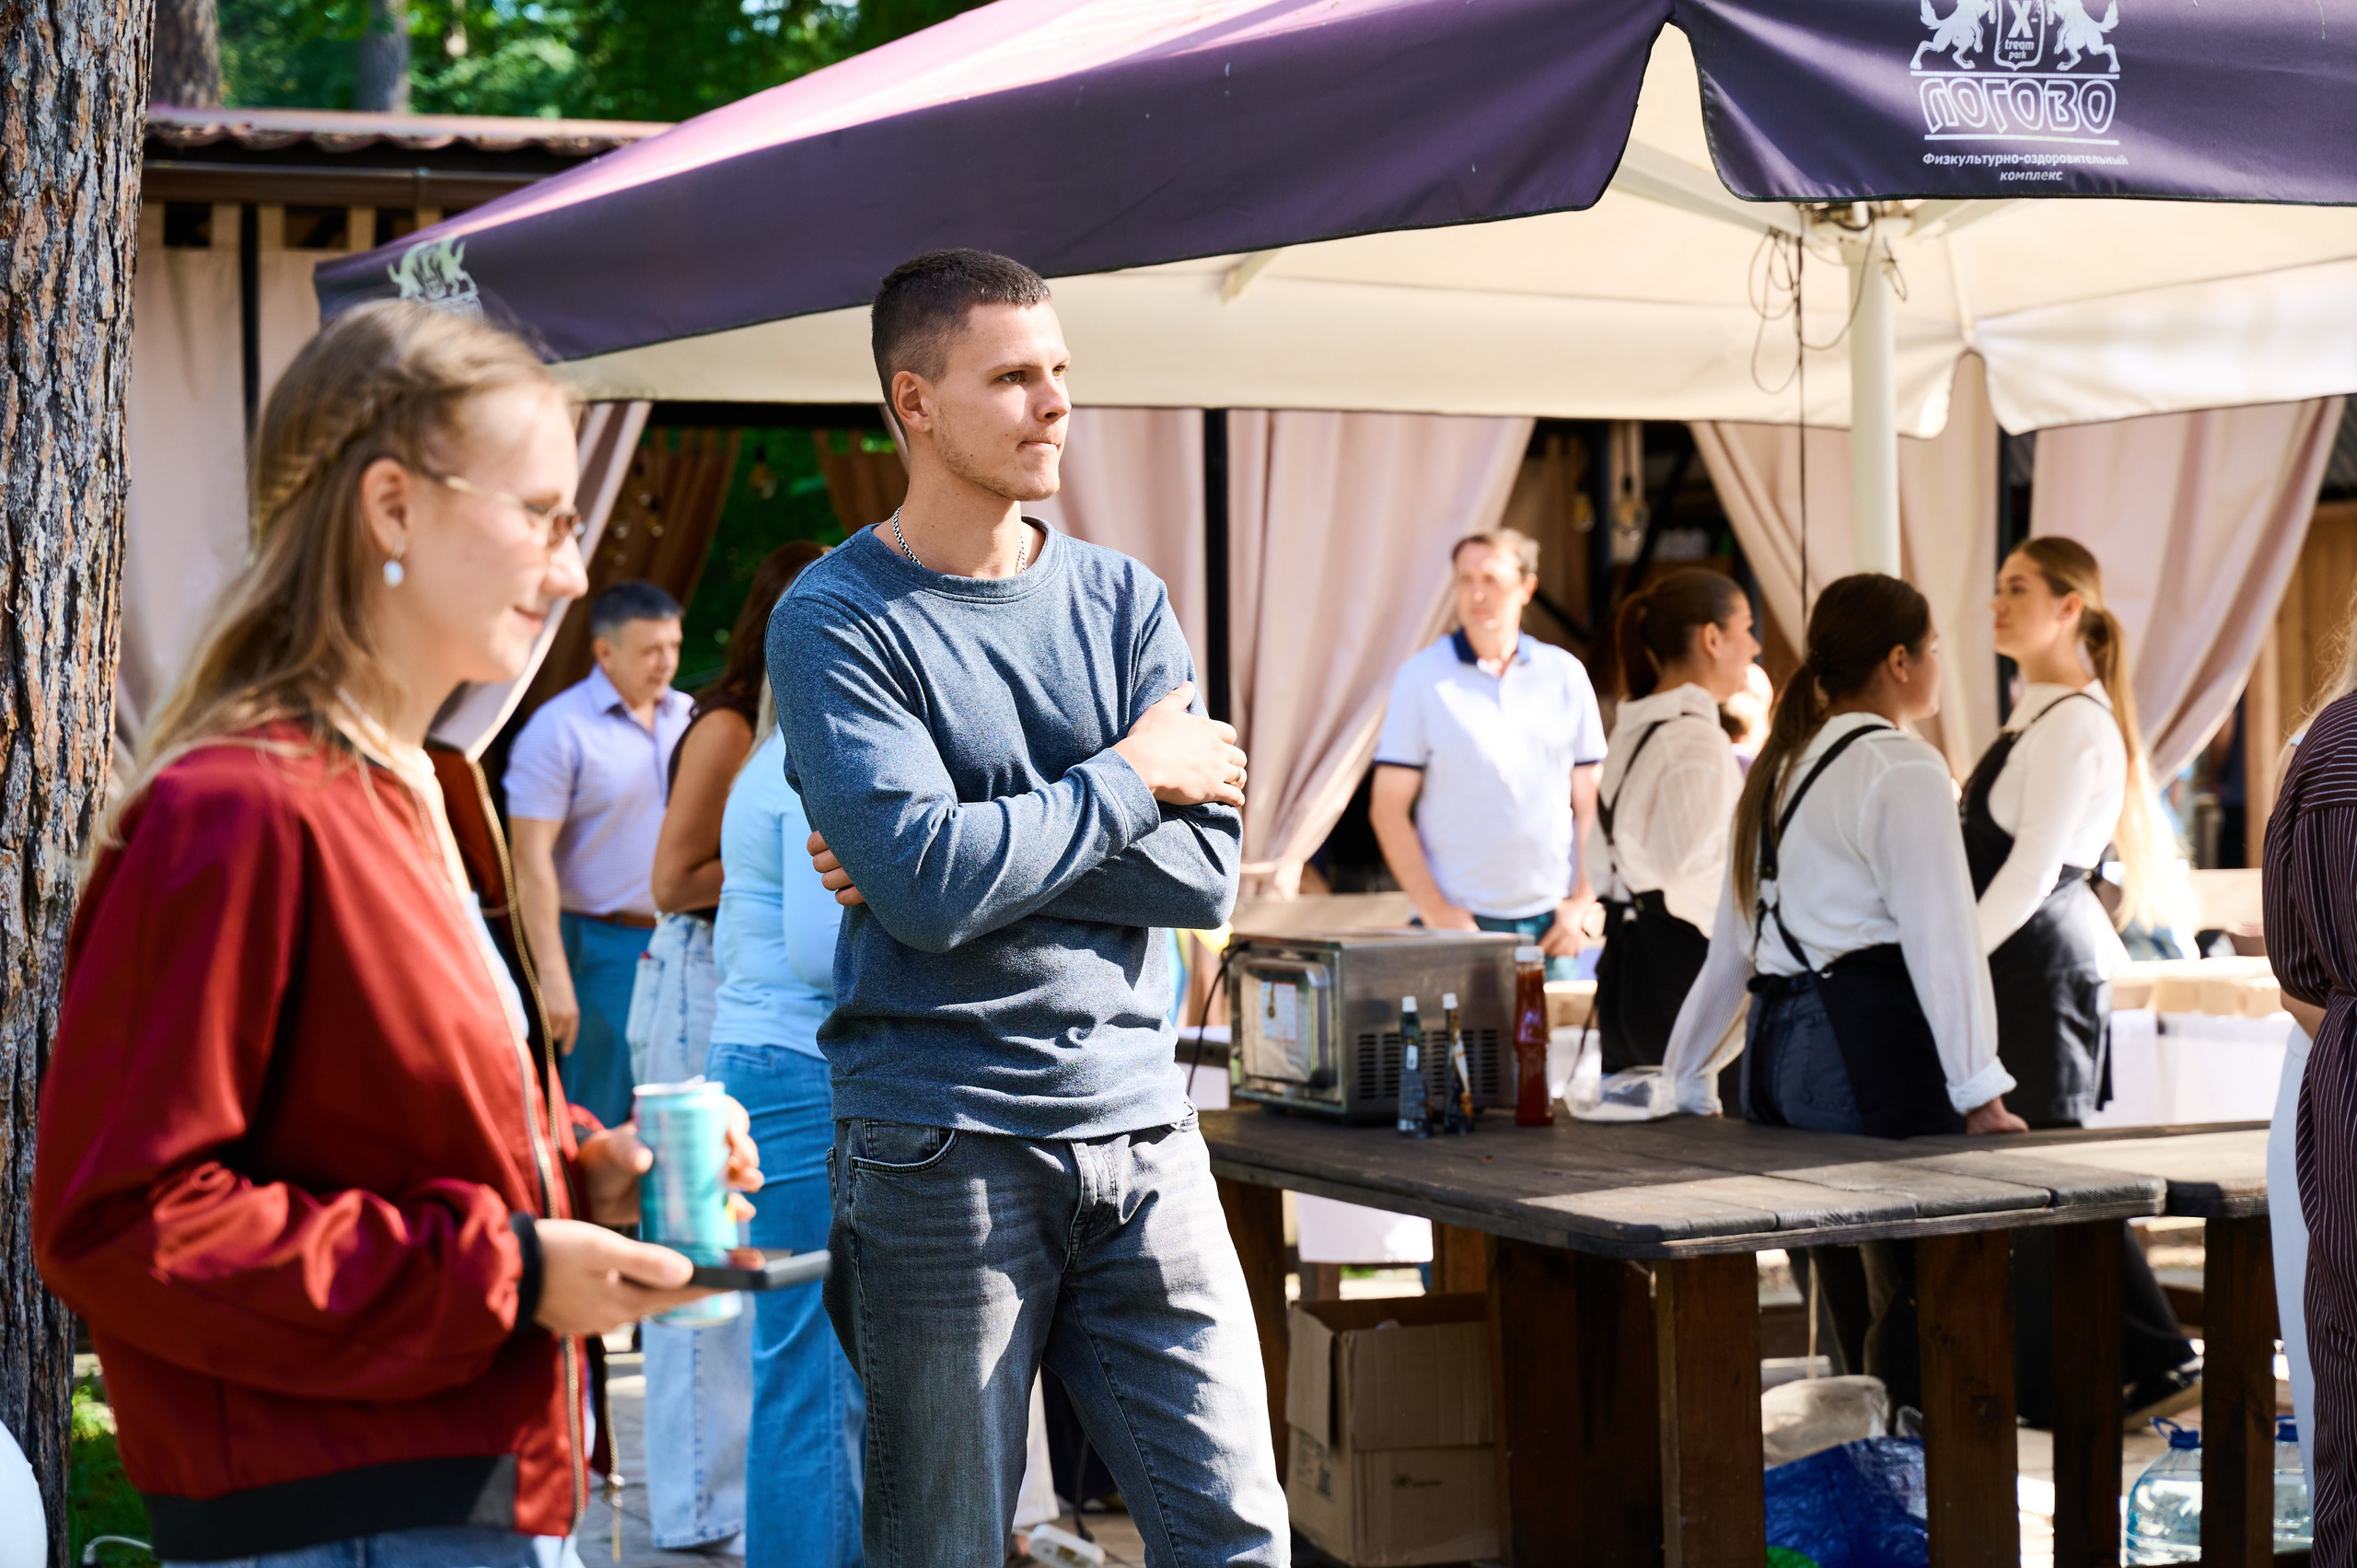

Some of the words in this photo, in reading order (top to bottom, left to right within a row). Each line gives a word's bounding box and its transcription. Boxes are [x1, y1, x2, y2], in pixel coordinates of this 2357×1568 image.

[2004, 39, 2035, 50] tream
[2008, 51, 2026, 61] park
[1920, 77, 2116, 134] ЛОГОВО
[1922, 153, 2129, 166] Физкультурно-оздоровительный
[2000, 170, 2063, 181] комплекс
